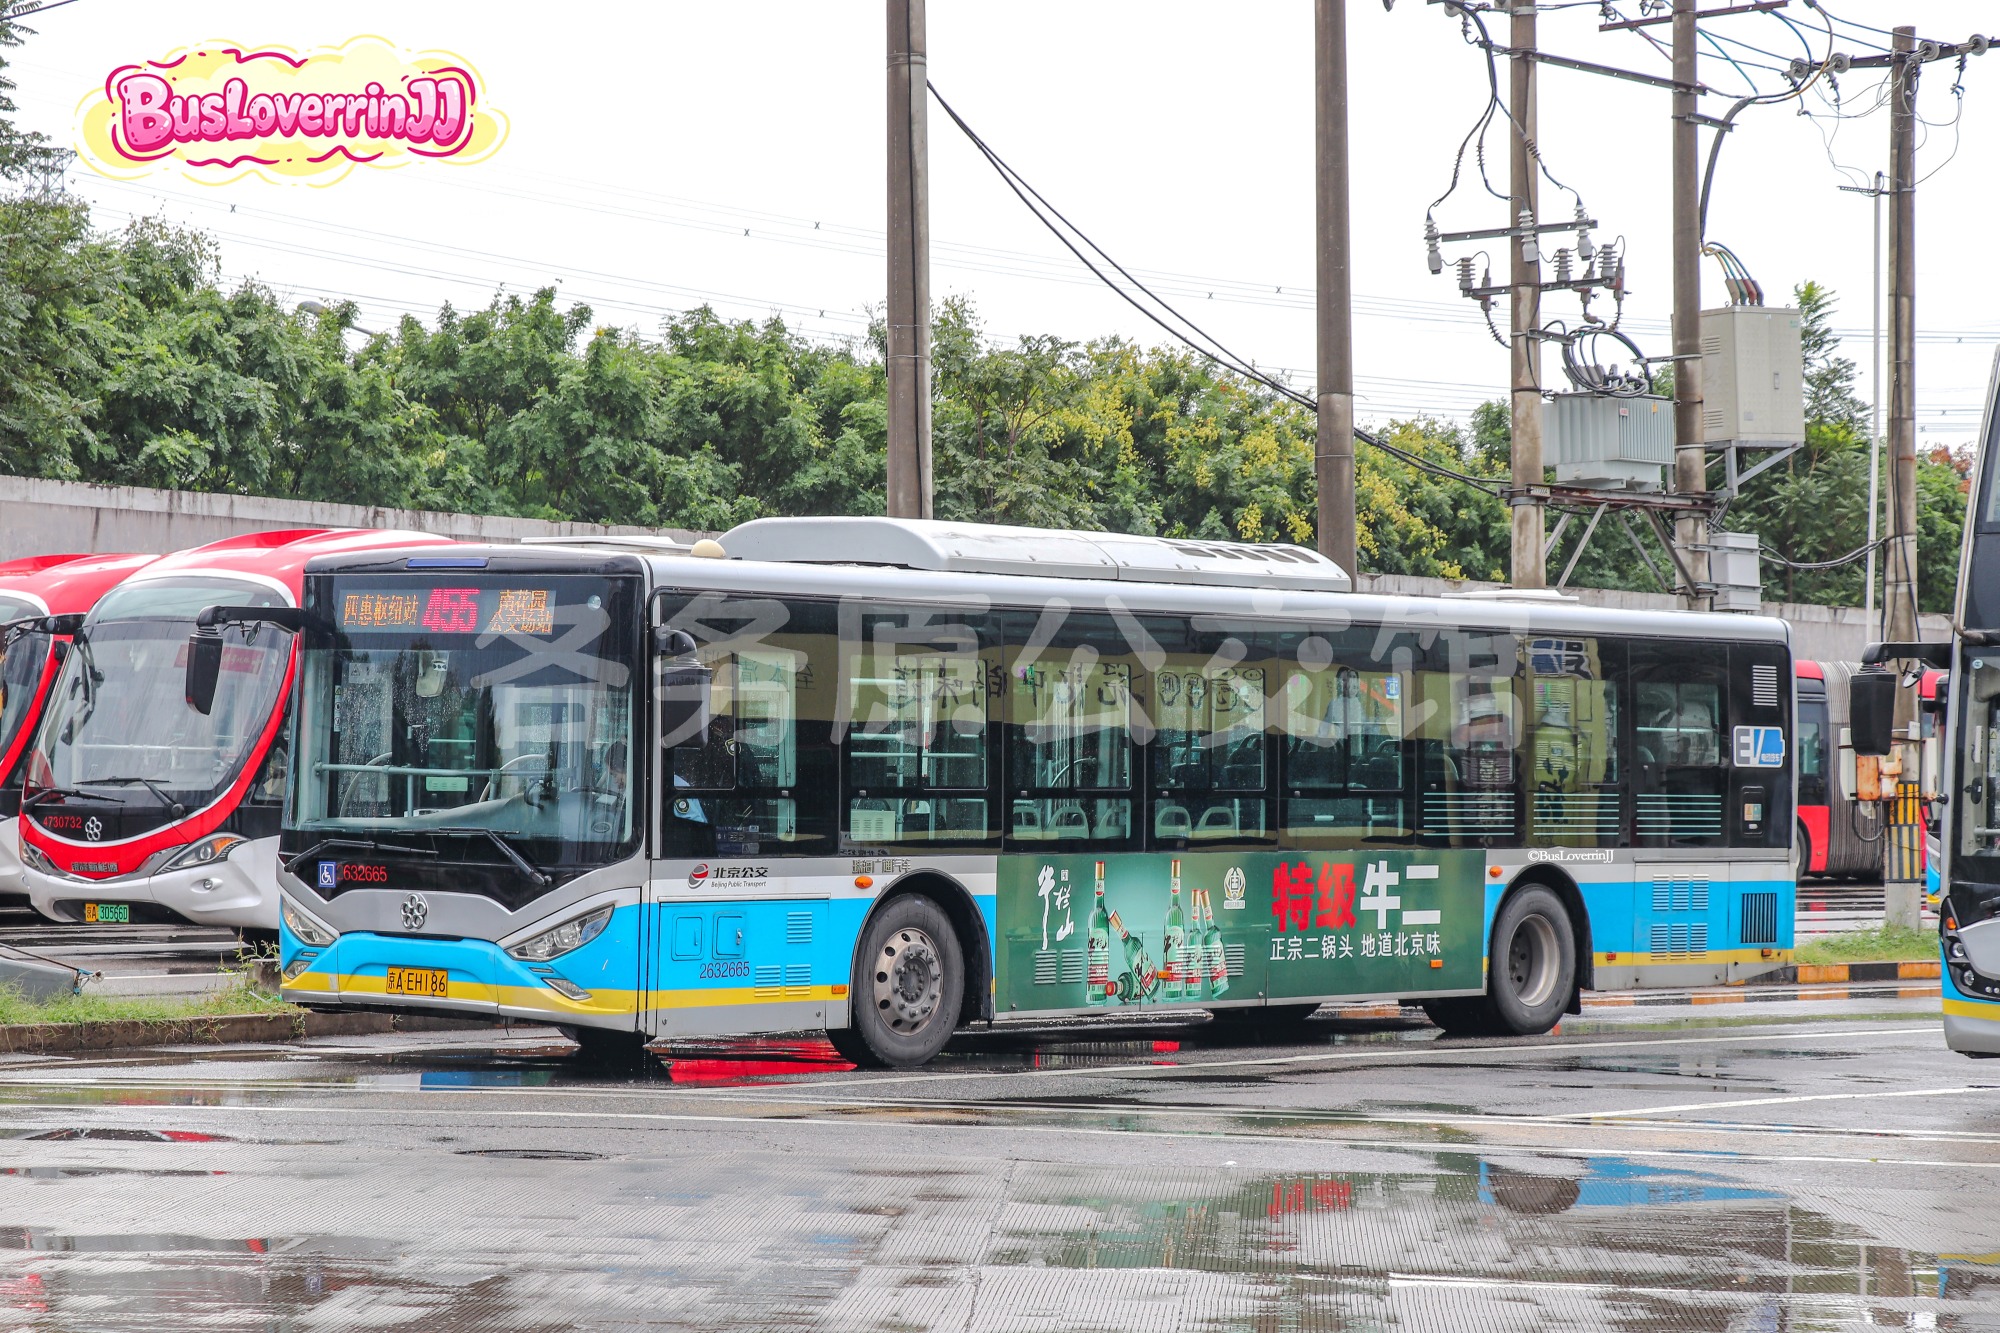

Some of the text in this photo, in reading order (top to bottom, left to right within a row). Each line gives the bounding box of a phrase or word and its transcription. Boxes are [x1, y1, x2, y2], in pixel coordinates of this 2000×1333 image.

[344, 593, 419, 627] 四惠枢纽站
[422, 588, 481, 632] 455
[499, 589, 548, 611] 南花园
[491, 609, 553, 633] 公交场站
[43, 816, 82, 829] 4730732
[711, 881, 728, 889] Beijing
[743, 880, 767, 888] Transport
[713, 866, 769, 879] 北京公交
[1037, 864, 1075, 951] 牛栏山
[1271, 860, 1442, 933] 特级牛二
[1270, 931, 1441, 961] 正宗二锅头 地道北京味
[699, 961, 750, 979] 2632665
